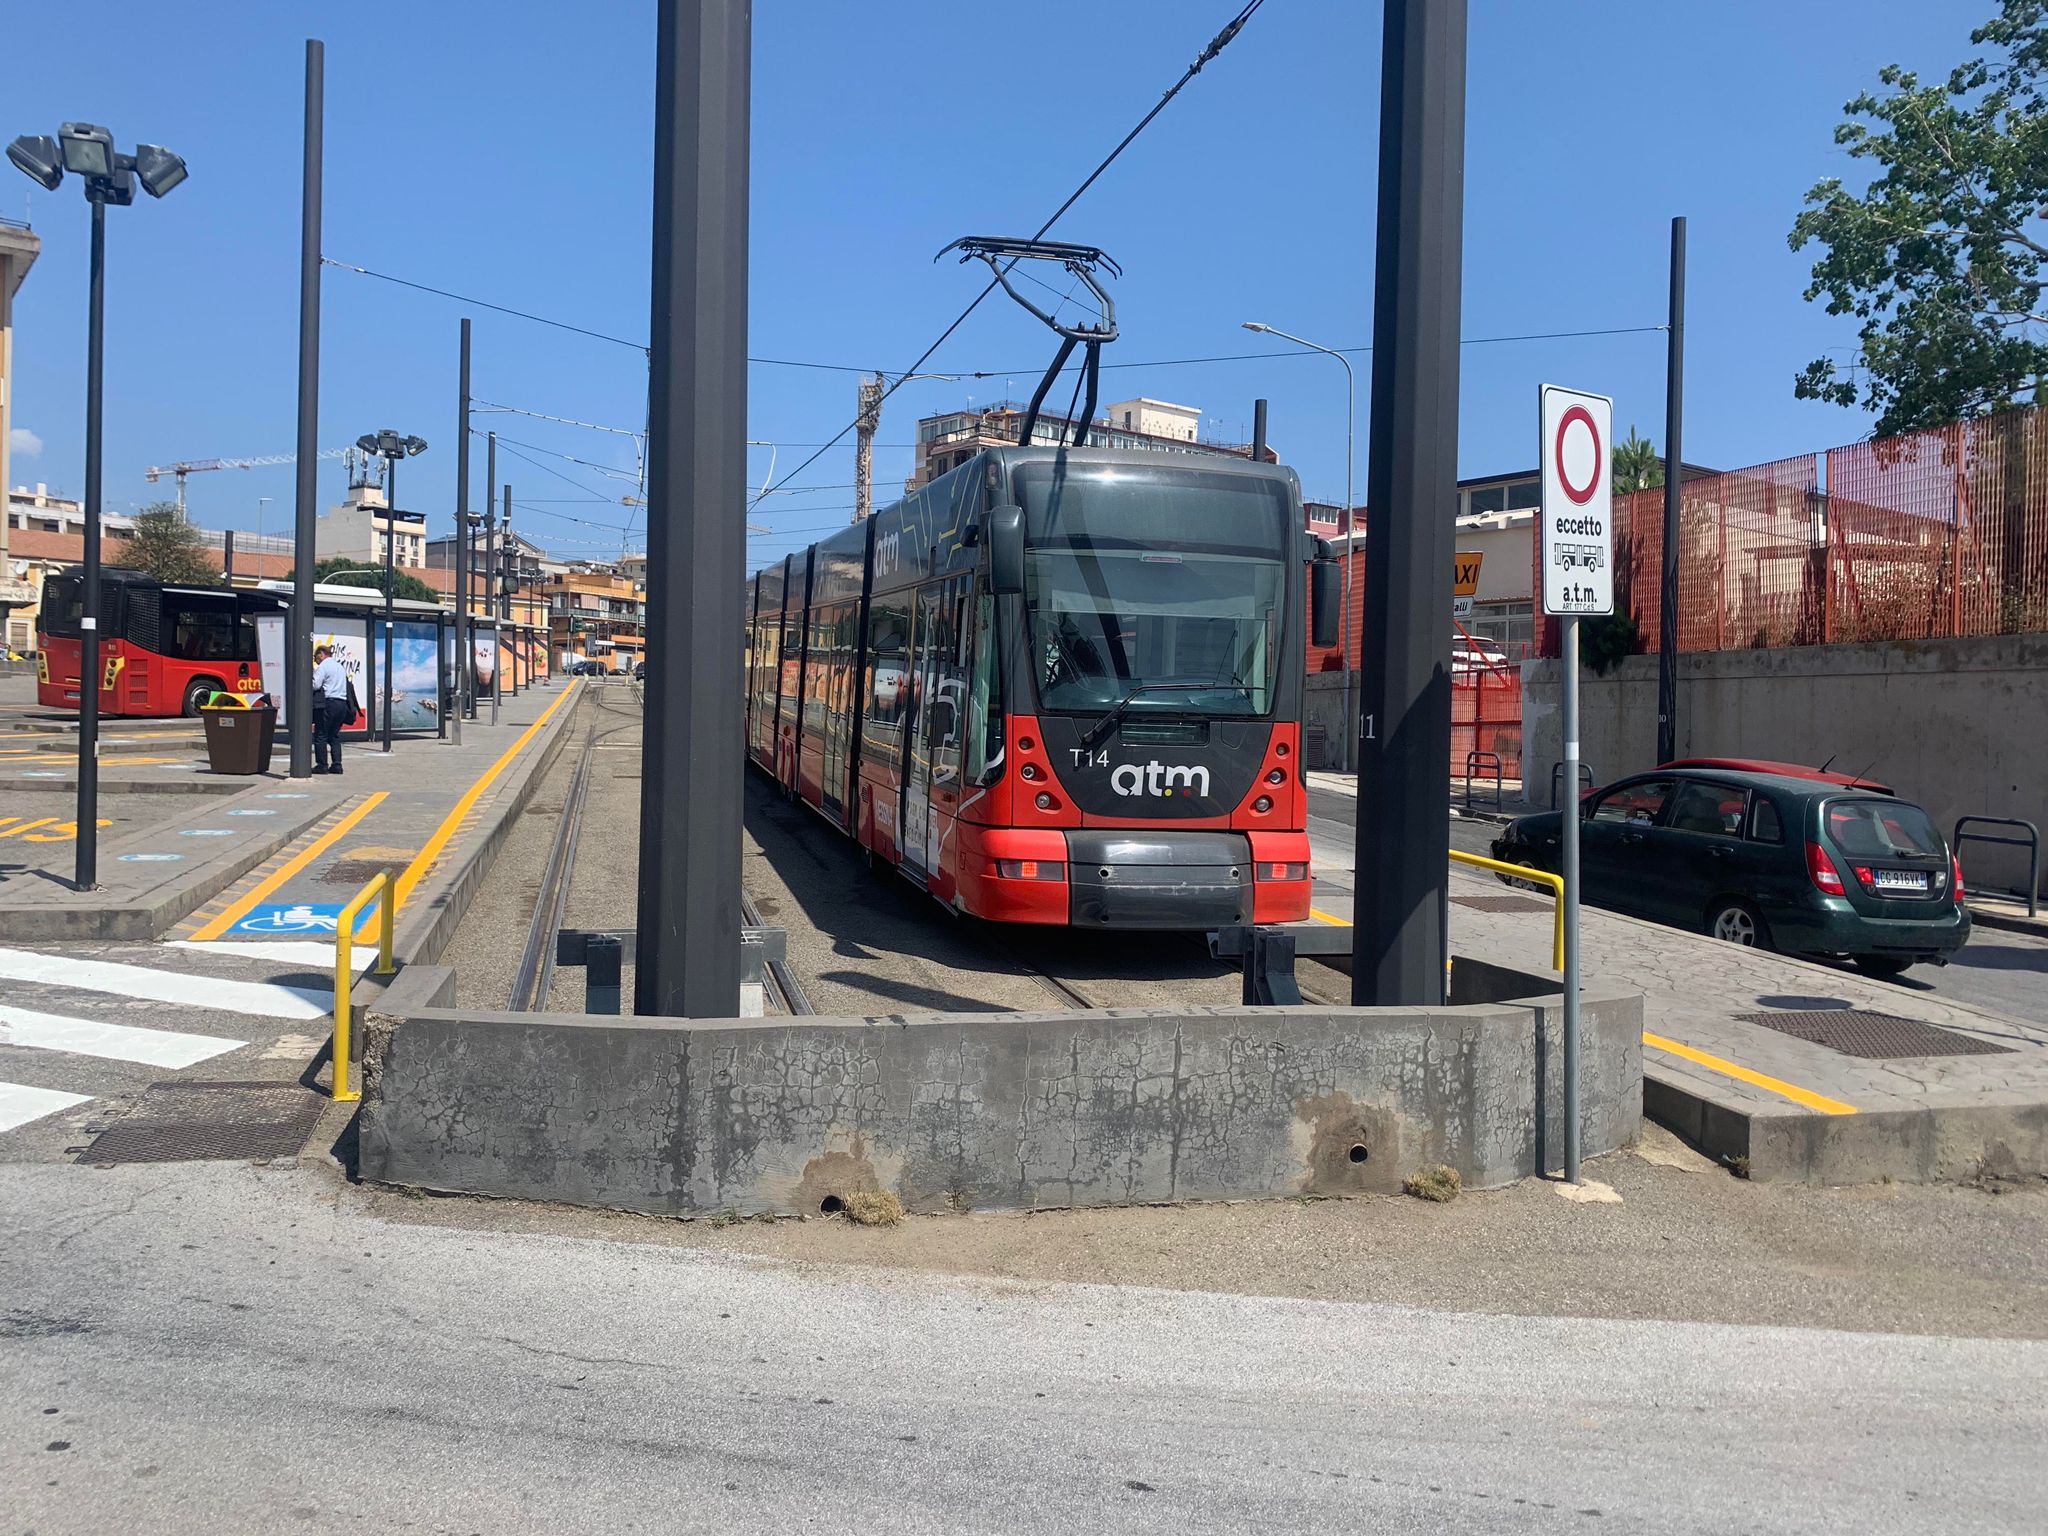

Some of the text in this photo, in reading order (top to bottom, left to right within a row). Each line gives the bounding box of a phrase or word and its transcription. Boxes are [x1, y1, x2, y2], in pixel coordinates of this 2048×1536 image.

[1556, 515, 1602, 536] eccetto
[875, 531, 899, 578] atm
[1563, 582, 1597, 603] a.t.m.
[1360, 713, 1376, 739] 11
[1069, 748, 1110, 768] T14
[1110, 760, 1210, 797] atm
